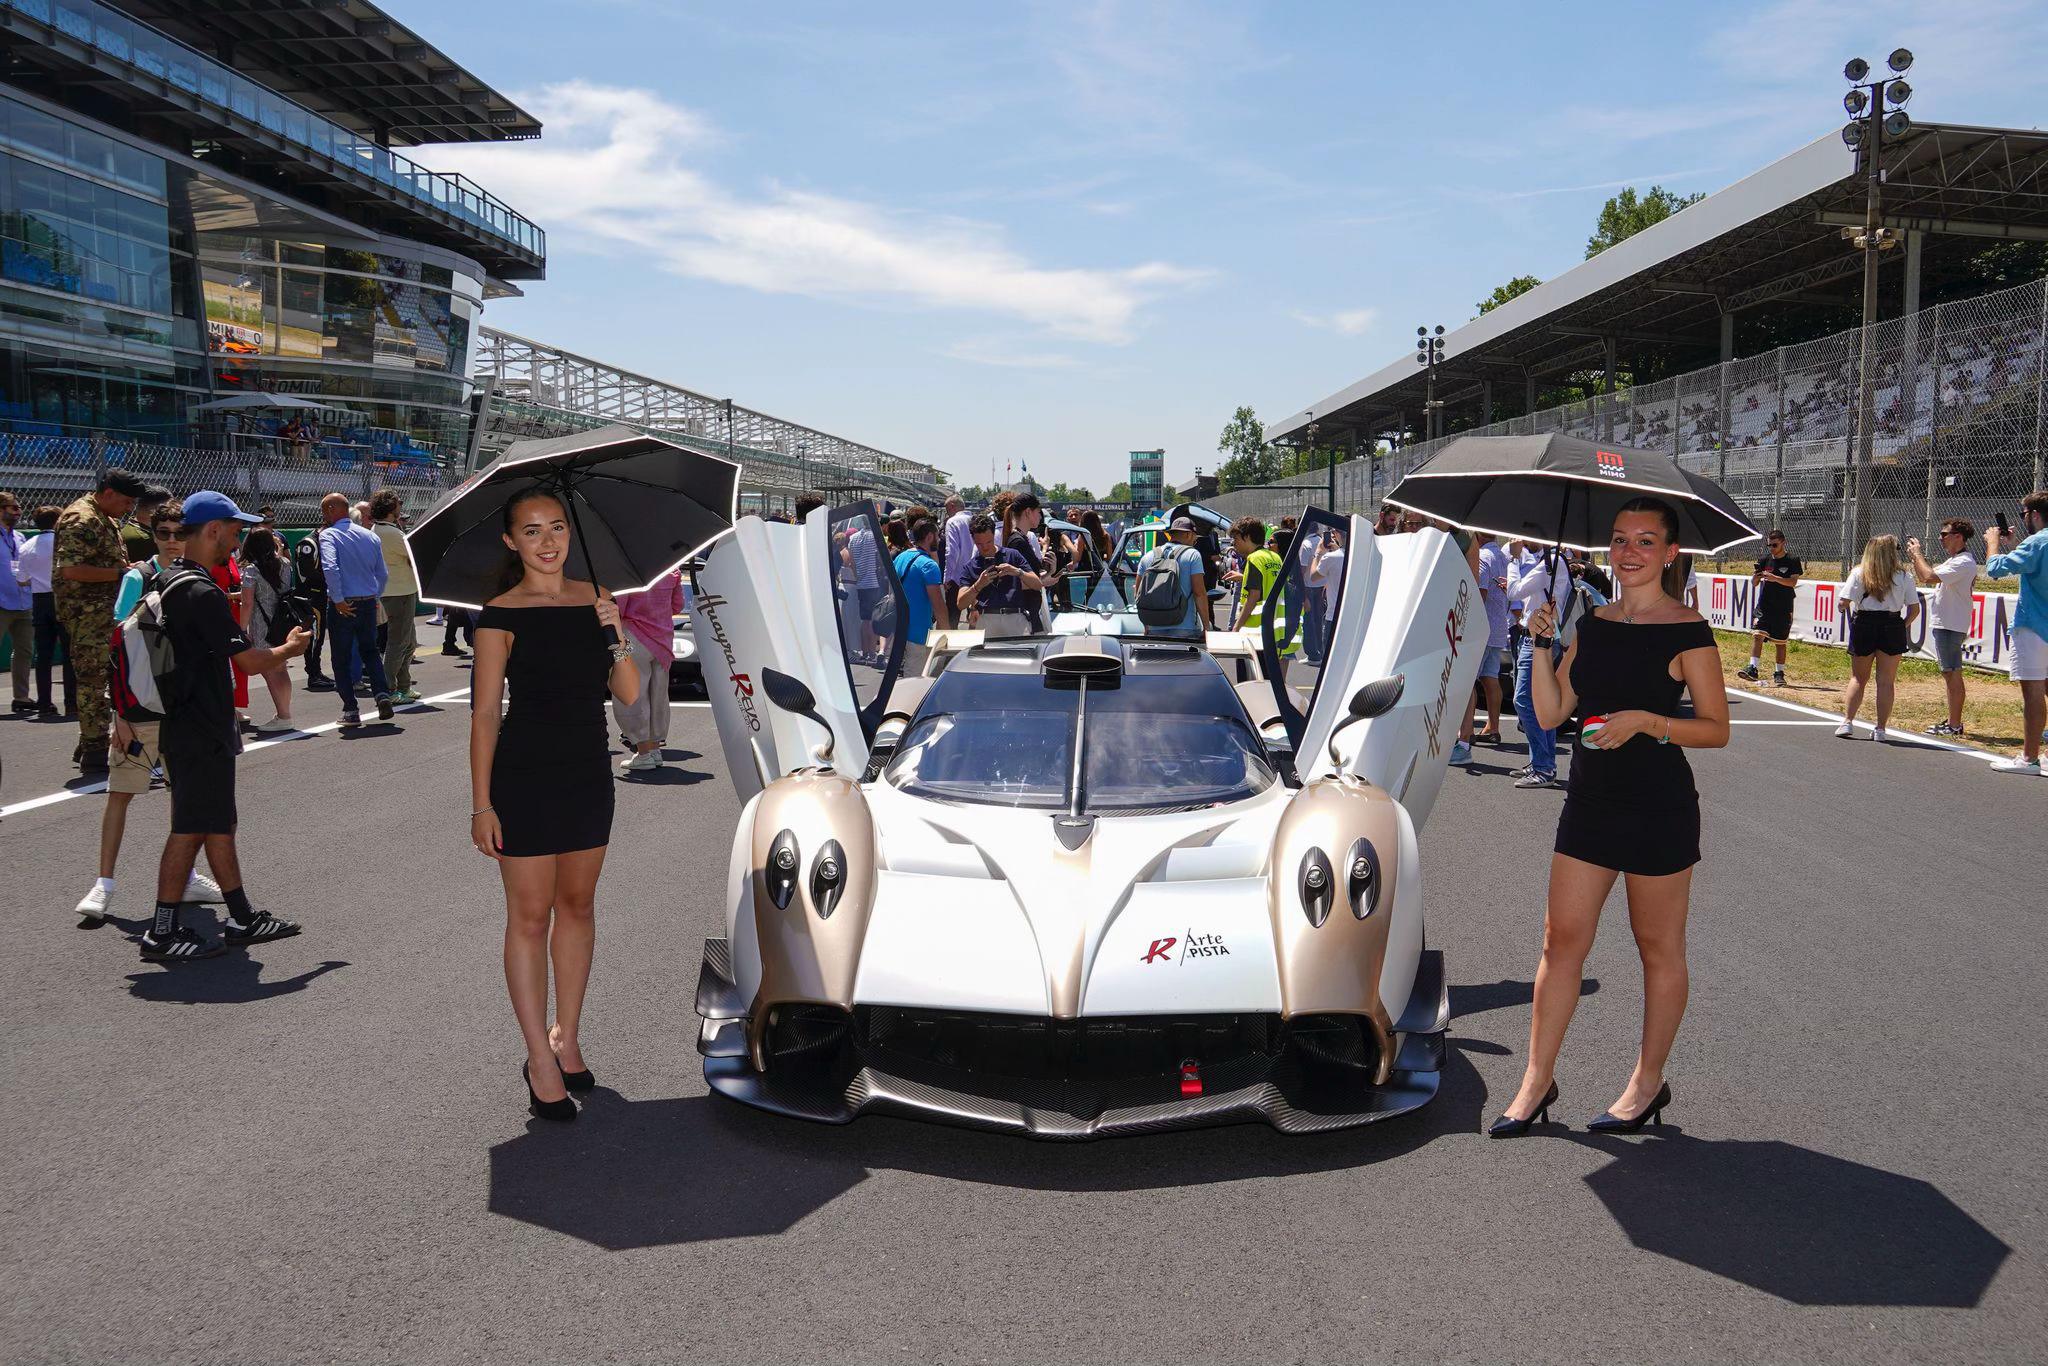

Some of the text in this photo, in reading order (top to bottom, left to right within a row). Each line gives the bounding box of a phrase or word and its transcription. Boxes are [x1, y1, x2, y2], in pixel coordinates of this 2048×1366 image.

[1599, 469, 1626, 479] MIMO
[696, 586, 736, 675] Huayra
[1423, 652, 1453, 760] Huayra
[1189, 945, 1230, 958] PISTA
